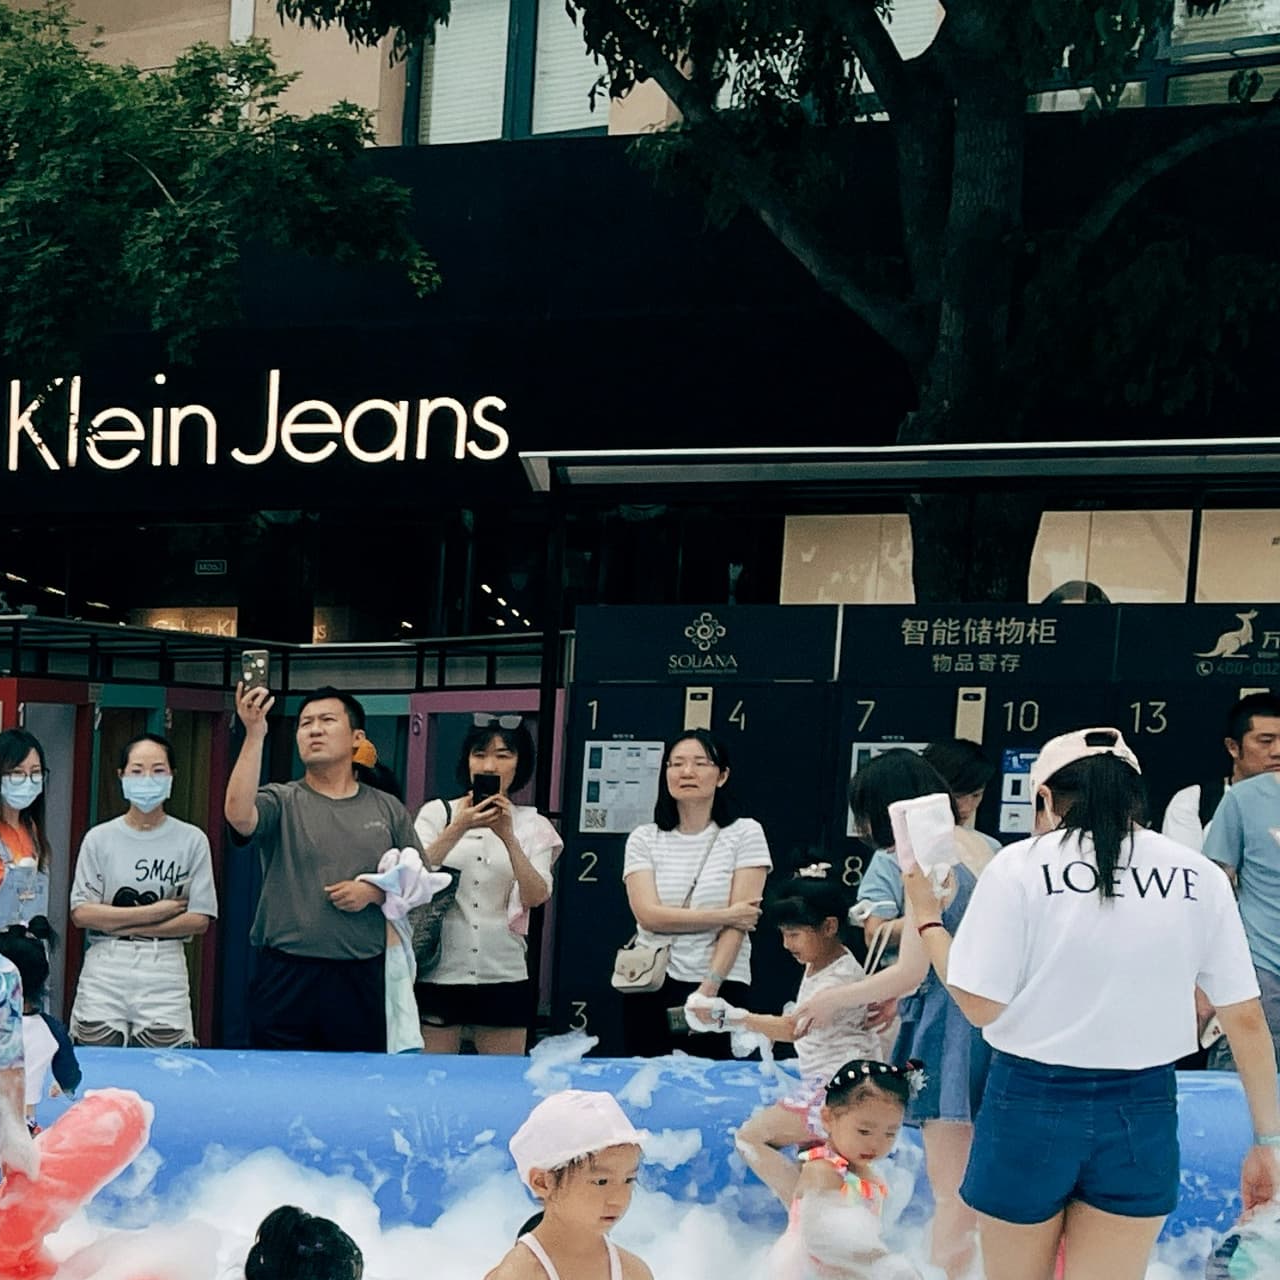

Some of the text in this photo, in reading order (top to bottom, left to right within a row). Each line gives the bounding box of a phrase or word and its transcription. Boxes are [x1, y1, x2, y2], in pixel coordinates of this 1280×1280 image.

[9, 374, 216, 471] Klein
[231, 369, 509, 464] Jeans
[901, 617, 1058, 646] 智能储物柜
[667, 654, 738, 669] SOLANA
[932, 653, 1021, 673] 物品寄存
[587, 700, 598, 730] 1
[728, 700, 746, 731] 4
[857, 700, 875, 732] 7
[1003, 701, 1039, 732] 10
[1130, 702, 1167, 733] 13
[578, 851, 598, 882] 2
[842, 856, 862, 886] 8
[1041, 860, 1199, 901] LOEWE
[569, 1001, 588, 1032] 3
